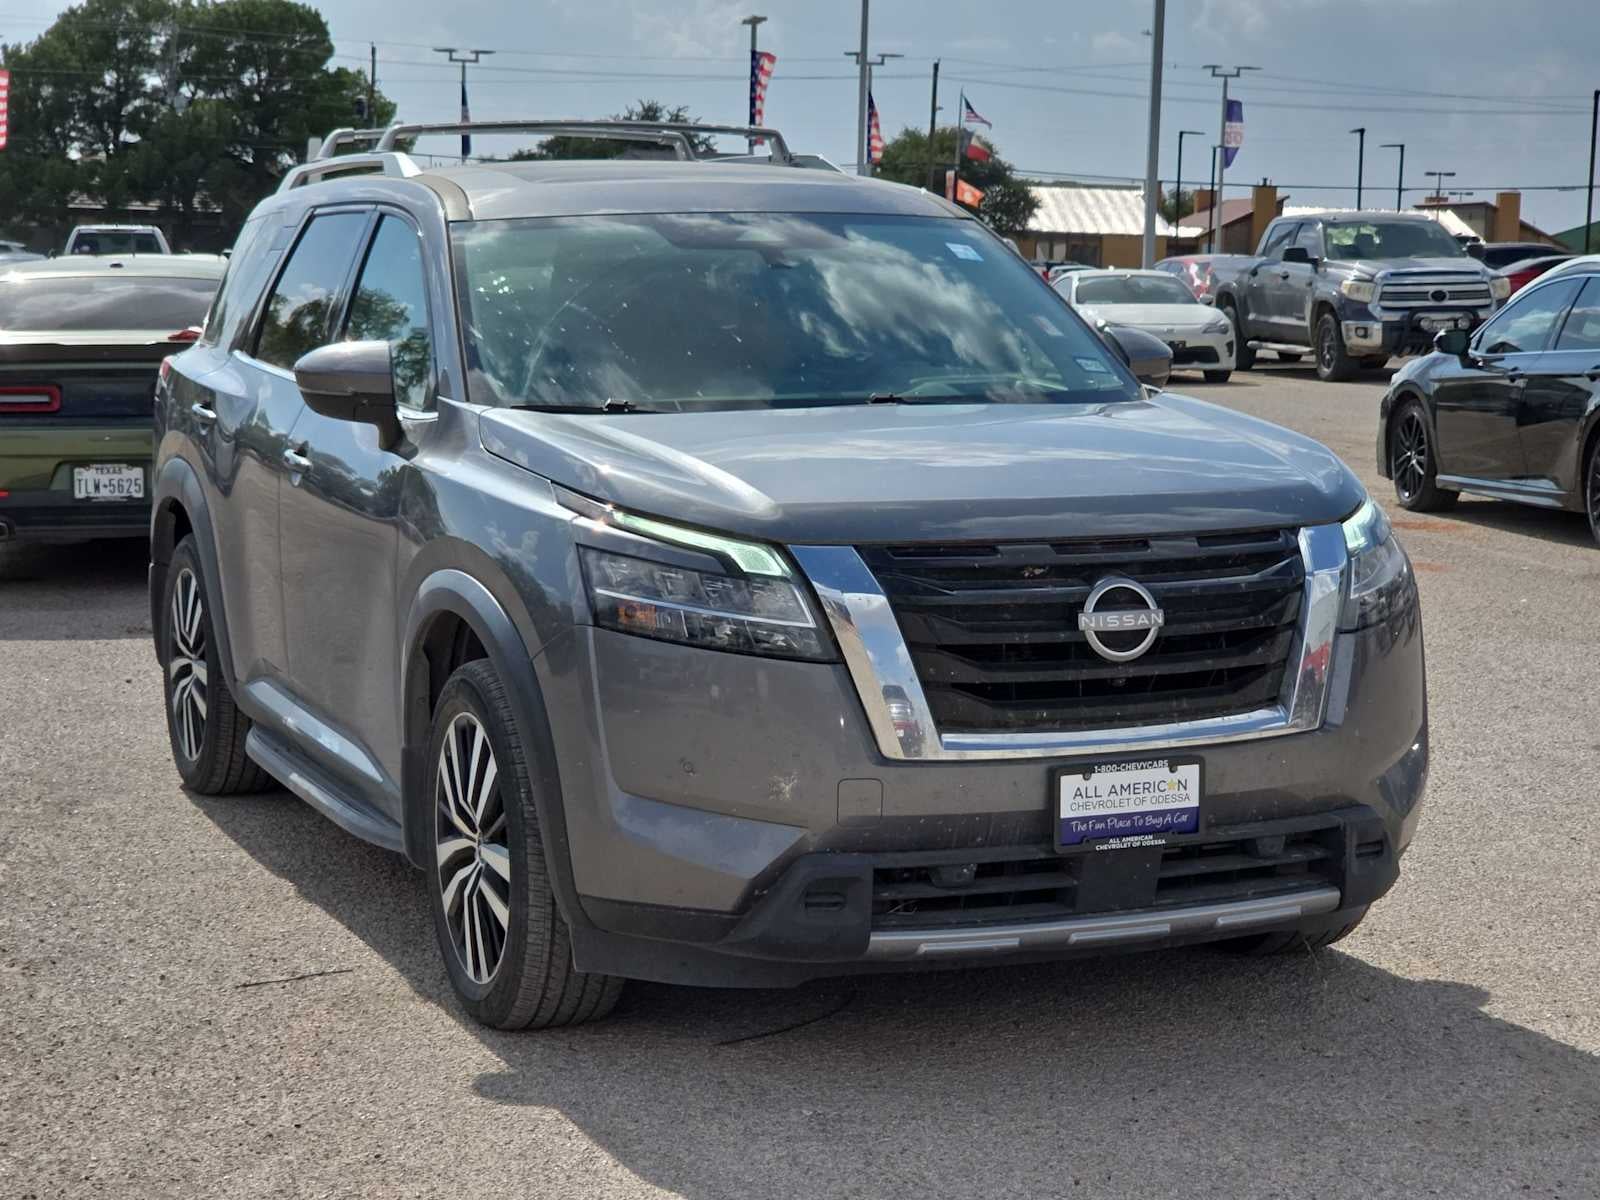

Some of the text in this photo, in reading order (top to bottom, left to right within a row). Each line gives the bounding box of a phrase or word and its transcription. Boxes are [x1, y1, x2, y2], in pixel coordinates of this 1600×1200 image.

[1081, 613, 1163, 628] NISSAN
[1094, 760, 1169, 774] 1-800-CHEVYCARS
[1073, 785, 1103, 800] ALL
[1070, 793, 1191, 812] CHEVROLET OF ODESSA
[1071, 812, 1189, 833] The Fun Place To Buy A Car
[1095, 842, 1131, 851] CHEVROLET
[1143, 839, 1166, 847] ODESSA
